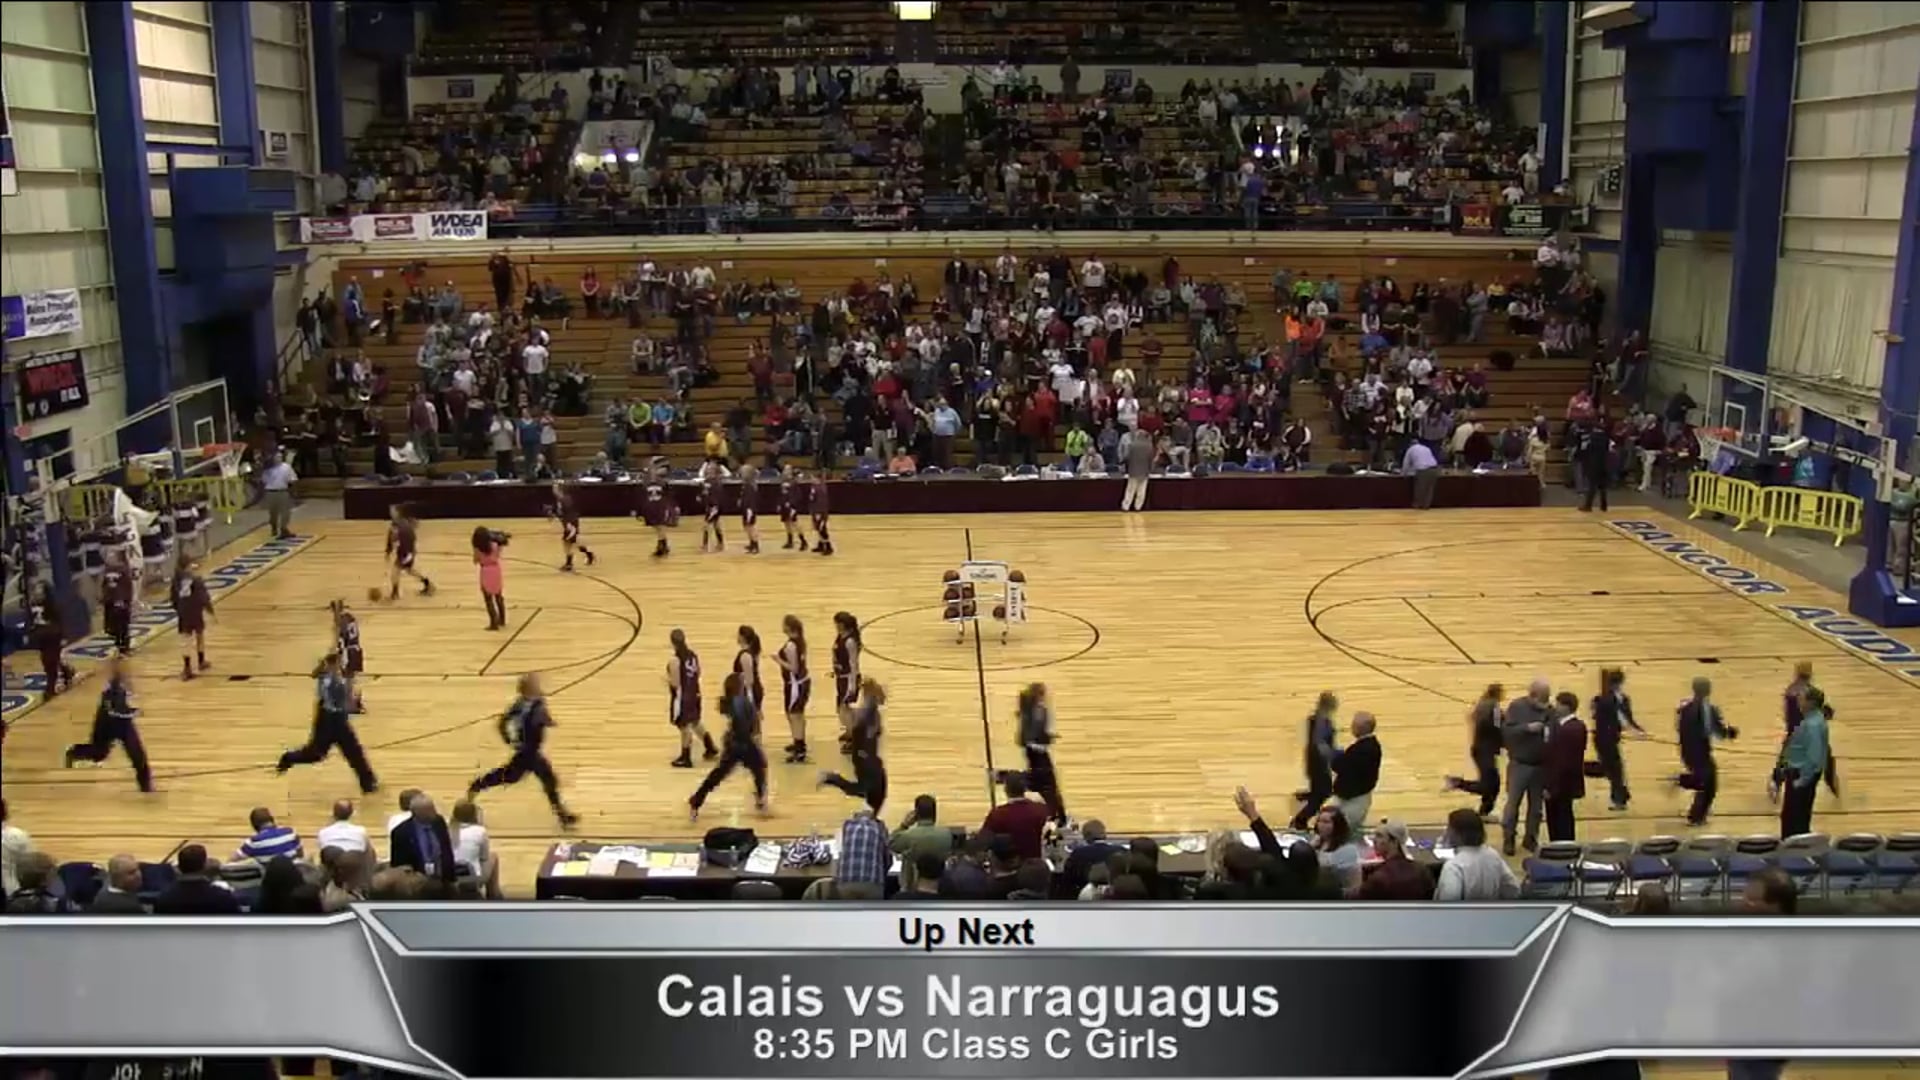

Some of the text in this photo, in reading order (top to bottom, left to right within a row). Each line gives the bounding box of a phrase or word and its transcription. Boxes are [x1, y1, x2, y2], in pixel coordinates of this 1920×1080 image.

[432, 214, 482, 227] WDEA
[1609, 519, 1789, 595] BANGOR
[1772, 604, 1920, 678] AUDI
